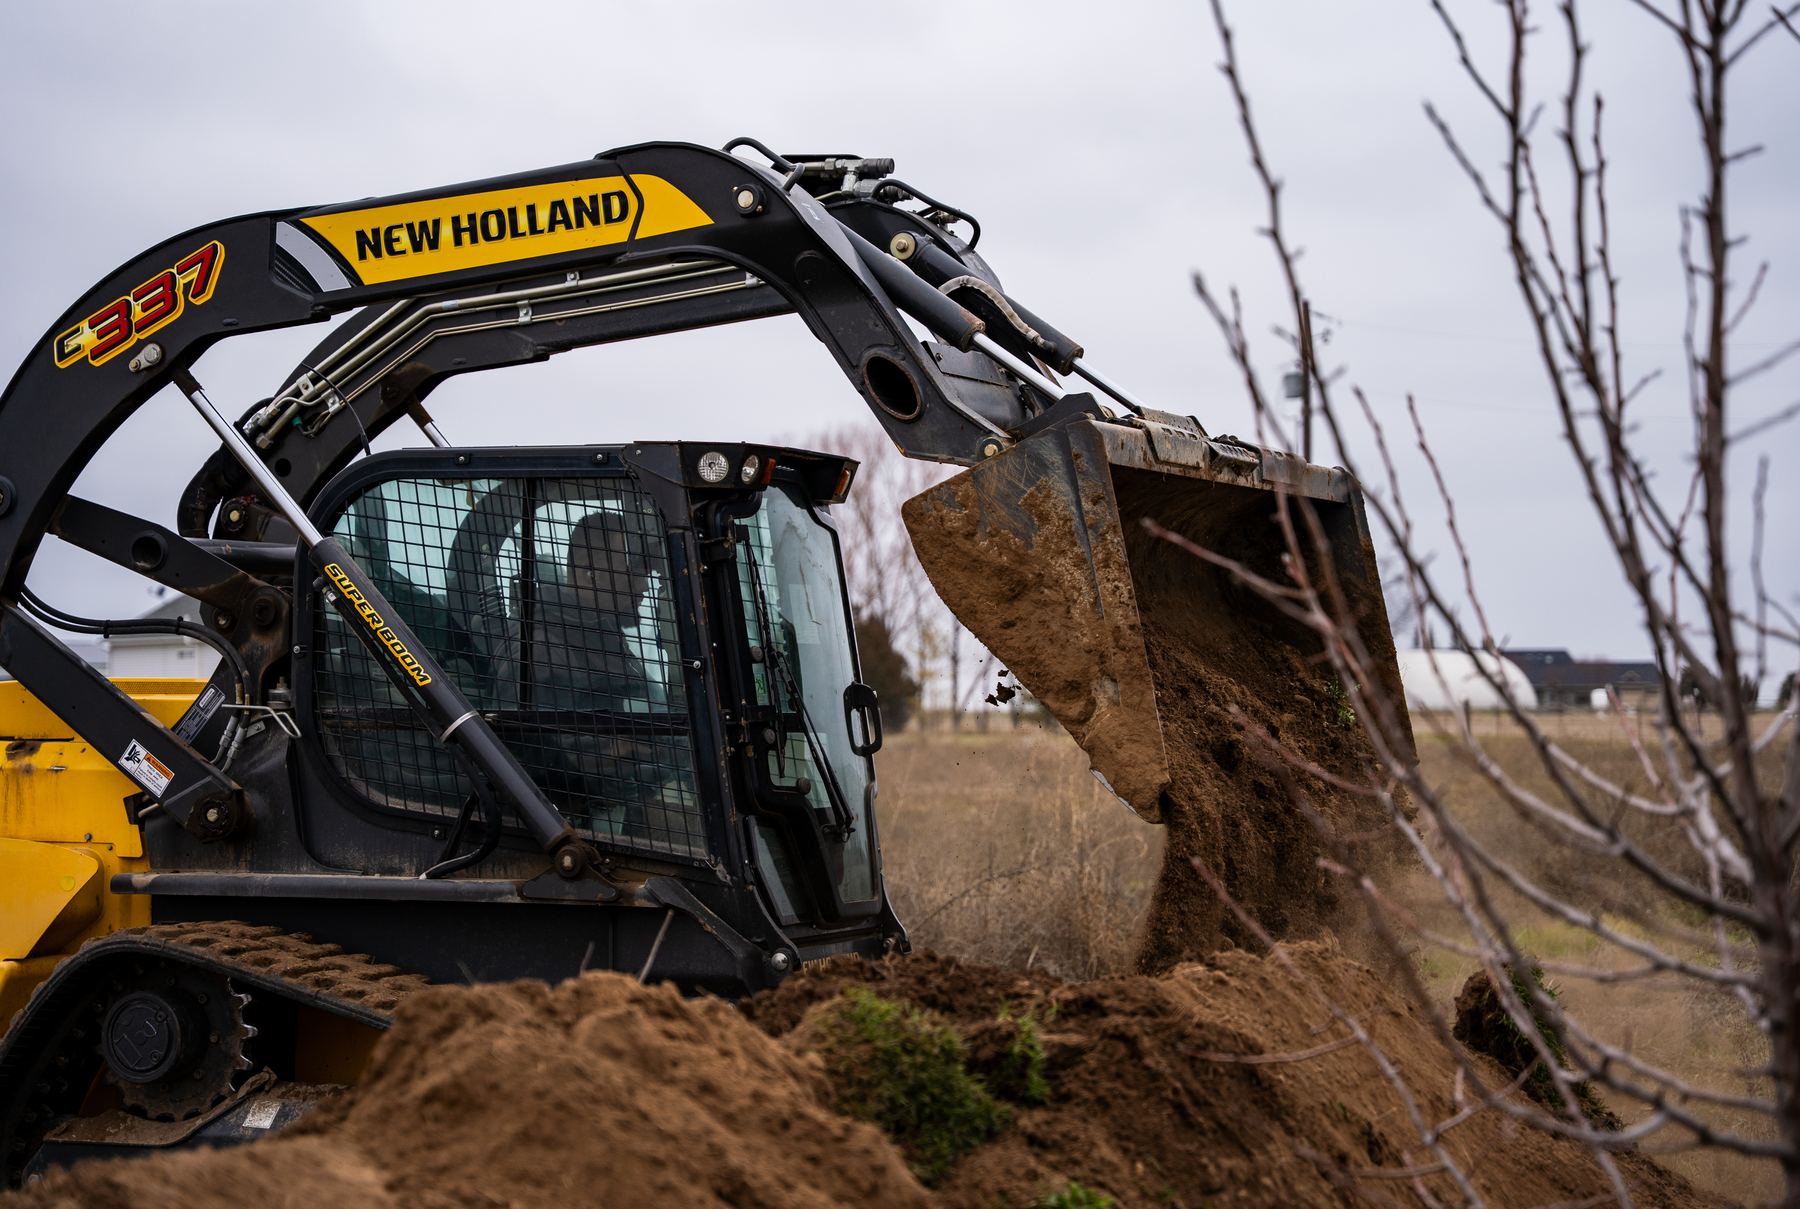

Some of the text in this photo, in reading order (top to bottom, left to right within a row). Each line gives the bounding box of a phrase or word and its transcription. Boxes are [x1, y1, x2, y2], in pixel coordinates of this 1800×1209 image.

[355, 190, 629, 262] NEW HOLLAND
[54, 240, 225, 369] C337
[324, 563, 432, 687] SUPER BOOM
